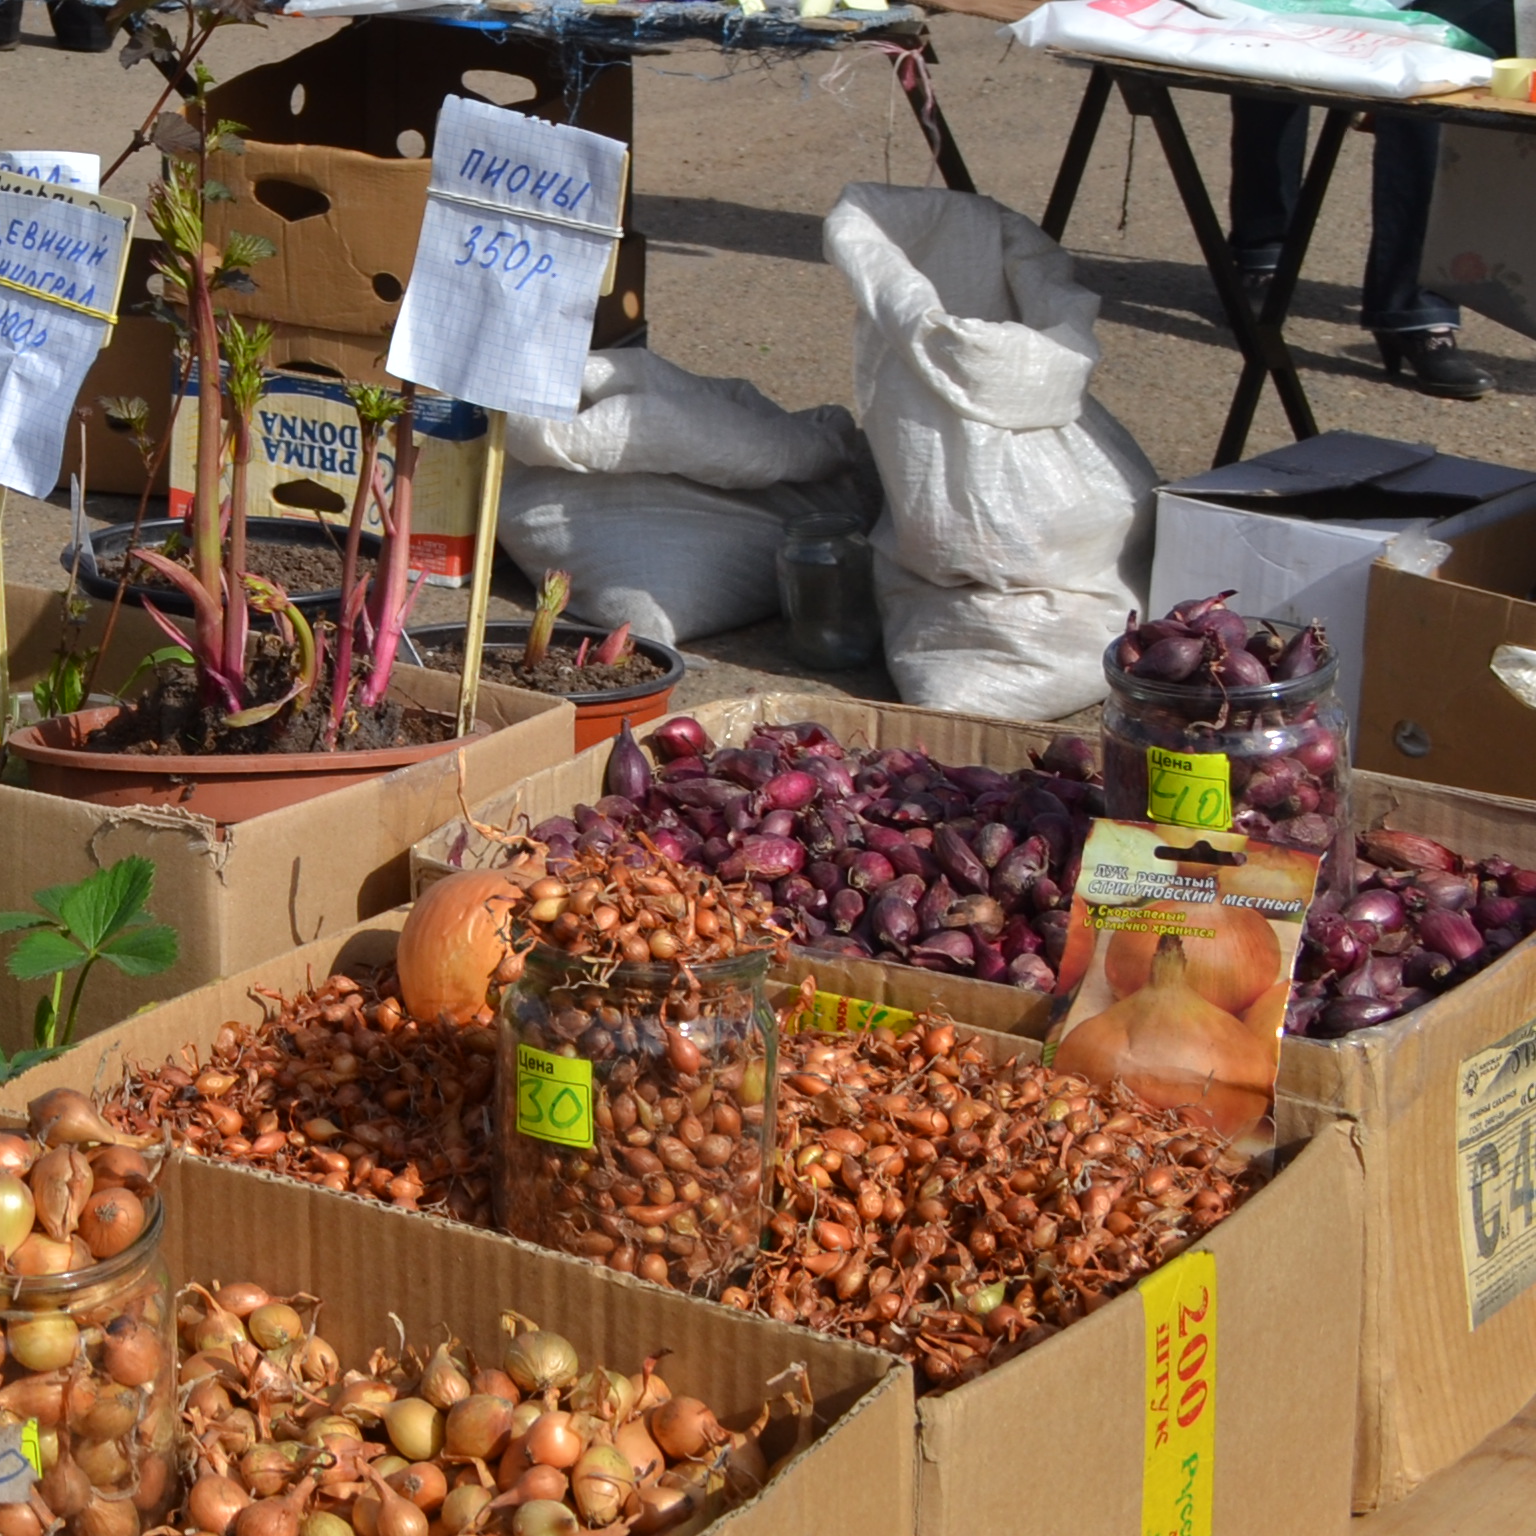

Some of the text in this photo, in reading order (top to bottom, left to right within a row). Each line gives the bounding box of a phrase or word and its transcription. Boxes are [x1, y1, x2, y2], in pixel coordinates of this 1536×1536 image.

[459, 148, 591, 212] ПИОНЫ
[259, 409, 359, 450] DONNA
[262, 435, 358, 476] PRIMA
[1151, 749, 1193, 772] Цена
[1094, 864, 1217, 890] ЛУК репчатый
[1088, 880, 1303, 913] СТРИГУНОВСКИЙ МЕСТНЫЙ
[1098, 905, 1186, 923] Скороспелый
[1095, 919, 1216, 939] Отлично хранится
[518, 1049, 555, 1075] Цена
[519, 1078, 584, 1130] 30
[1176, 1284, 1209, 1428] 200
[1150, 1322, 1170, 1450] штук
